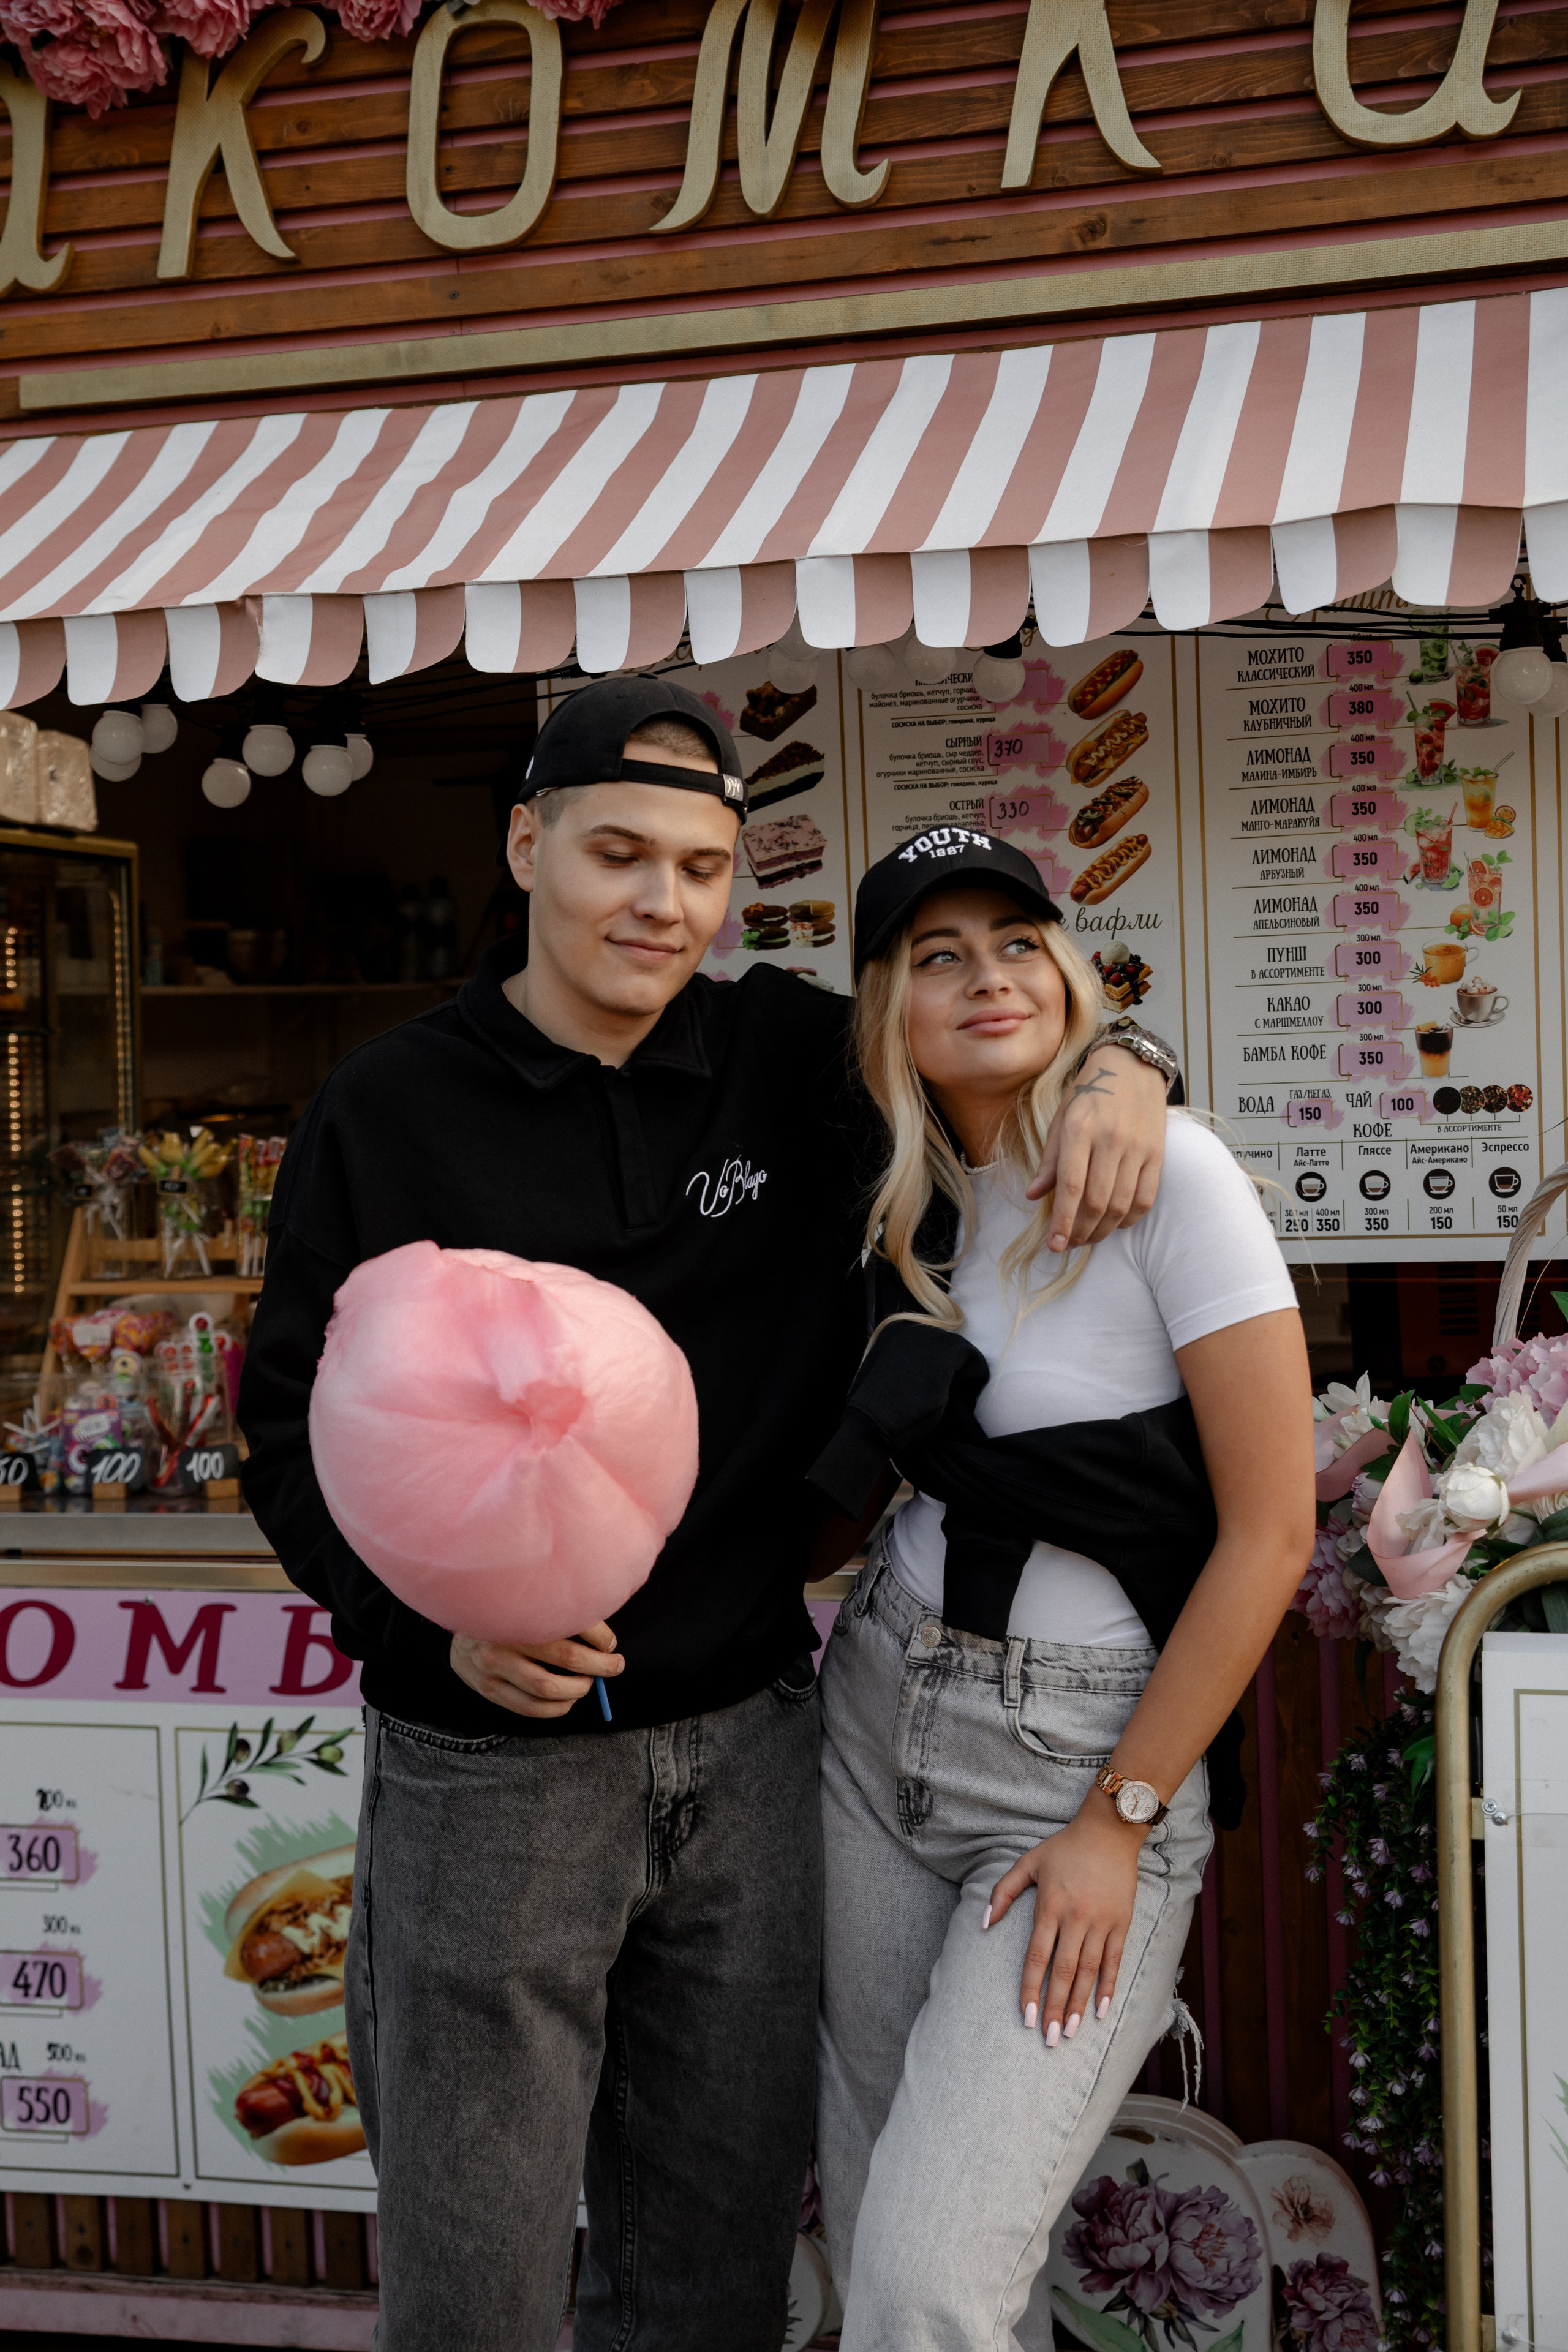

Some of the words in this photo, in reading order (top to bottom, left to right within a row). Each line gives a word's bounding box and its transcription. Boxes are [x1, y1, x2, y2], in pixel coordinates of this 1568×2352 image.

[1248, 647, 1304, 665] МОХИТО
[1348, 650, 1373, 665] 350
[1238, 664, 1315, 682] КЛАССИЧЕСКИЙ
[900, 698, 948, 707] маринованные
[1249, 697, 1306, 715] МОХИТО
[1349, 700, 1374, 715] 380
[1243, 714, 1312, 731] КЛУБНИЧНЫЙ
[945, 736, 982, 748] СЫРНЫЙ
[995, 739, 1023, 758] 370
[941, 758, 967, 766] сырный
[1246, 747, 1311, 765] ЛИМОНАД
[1350, 751, 1374, 765] 350
[876, 770, 906, 778] огурчики
[1242, 767, 1317, 782] МАЛИНА-ИМБИРЬ
[949, 798, 984, 811] ОСТРЫЙ
[997, 801, 1029, 820] 330
[1251, 796, 1315, 815] ЛИМОНАД
[1352, 801, 1376, 815] 350
[1241, 816, 1320, 831] МАНГО-МАРАКУЙЯ
[898, 827, 992, 864] YOUTH
[929, 845, 965, 859] 1887
[1252, 846, 1316, 864] ЛИМОНАД
[1353, 852, 1378, 866] 350
[1260, 867, 1305, 880] АРБУЗНЫЙ
[1254, 896, 1318, 914] ЛИМОНАД
[1354, 902, 1379, 915] 350
[1076, 907, 1163, 940] вафли
[1253, 916, 1320, 930] АПЕЛЬСИНОВЫЙ
[1267, 946, 1306, 962] ПУНШ
[1355, 951, 1381, 965] 300
[1251, 969, 1256, 979] В
[1258, 966, 1325, 979] АССОРТИМЕНТЕ
[1267, 996, 1310, 1012] КАКАО
[1357, 1001, 1382, 1015] 300
[1254, 1019, 1261, 1028] С
[1263, 1016, 1324, 1028] МАРШМЕЛЛОУ
[1243, 1046, 1286, 1062] БАМБЛ
[1291, 1044, 1327, 1060] КОФЕ
[1359, 1052, 1383, 1065] 350
[1238, 1096, 1275, 1114] ВОДА
[1346, 1091, 1373, 1108] ЧАЙ
[1390, 1098, 1414, 1111] 100
[1299, 1107, 1321, 1120] 150
[1352, 1123, 1392, 1137] КОФЕ
[1296, 1147, 1327, 1157] Латте
[1358, 1145, 1392, 1156] Гляссе
[1410, 1144, 1469, 1156] Американо
[1482, 1142, 1529, 1155] Эспрессо
[1412, 1156, 1468, 1165] Айс-Американо
[1316, 1219, 1340, 1232] 350
[1365, 1218, 1389, 1231] 350
[1431, 1216, 1452, 1229] 150
[1496, 1215, 1518, 1228] 150
[91, 1452, 141, 1484] 100
[186, 1451, 224, 1482] 100
[8, 1834, 60, 1872] 360
[13, 1961, 66, 1999] 470
[18, 2086, 70, 2124] 550
